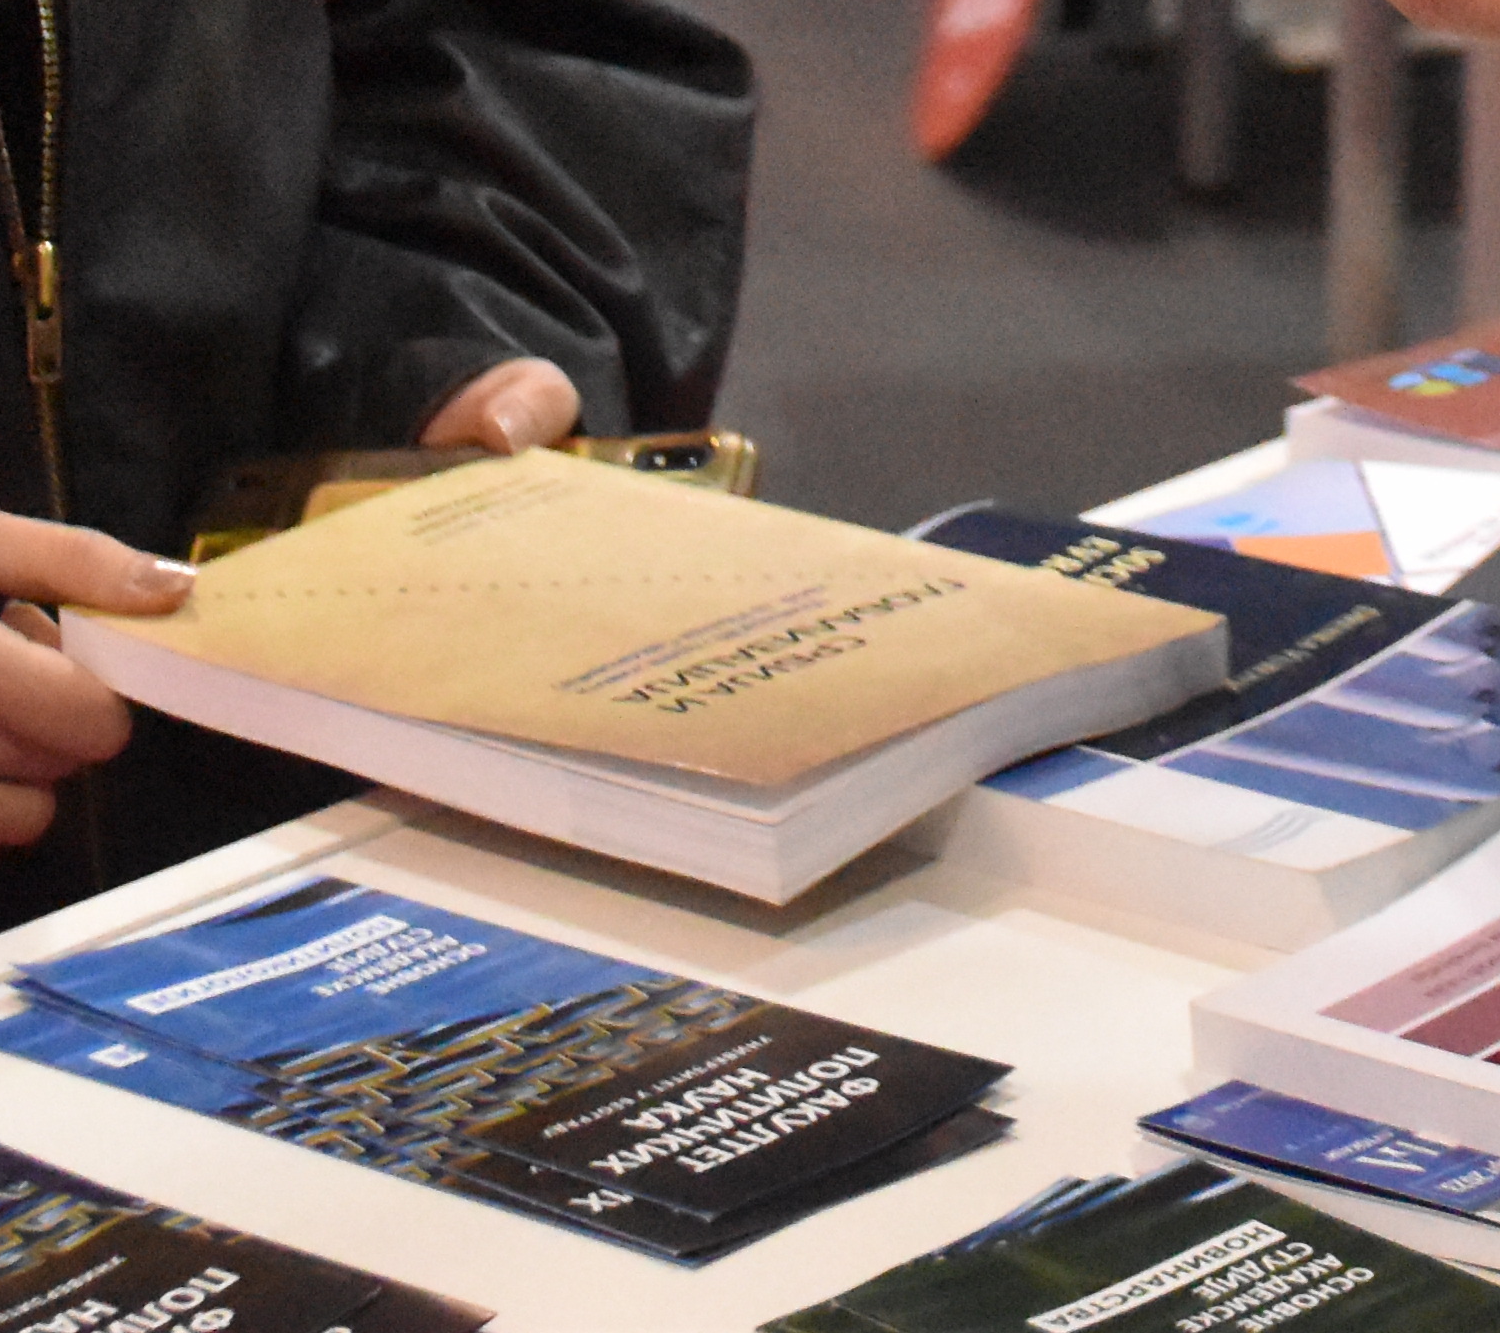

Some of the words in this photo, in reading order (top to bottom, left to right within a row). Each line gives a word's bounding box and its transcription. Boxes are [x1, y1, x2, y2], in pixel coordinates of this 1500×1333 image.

[589, 1046, 881, 1176] ПОЛИТИЧКИХ
[622, 1066, 771, 1132] НАУКА
[675, 1076, 881, 1173] ФАКУЛТЕТ
[1046, 1224, 1274, 1329] НОВИНАРСТВА
[1175, 1252, 1344, 1333] АКАДЕМСКЕ
[1192, 1241, 1315, 1301] СТУДИЈЕ
[1236, 1266, 1376, 1333] ОСНОВНЕ
